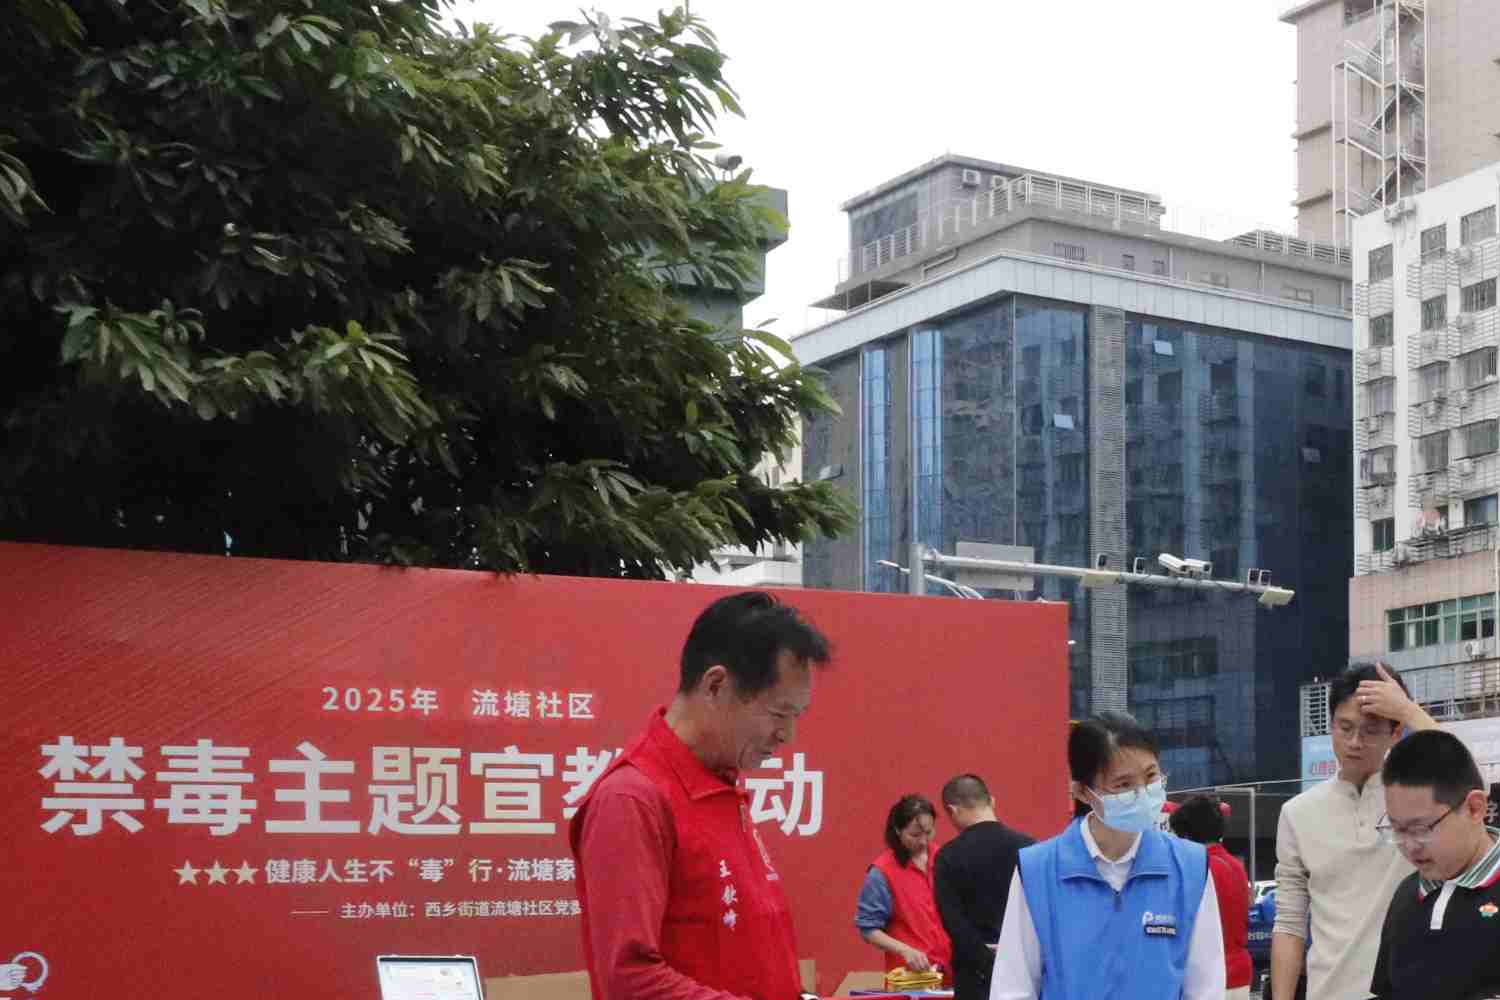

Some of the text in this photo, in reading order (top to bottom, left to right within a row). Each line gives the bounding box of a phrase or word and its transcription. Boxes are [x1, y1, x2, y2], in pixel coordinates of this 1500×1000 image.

[321, 686, 595, 719] 2025年 流塘社区
